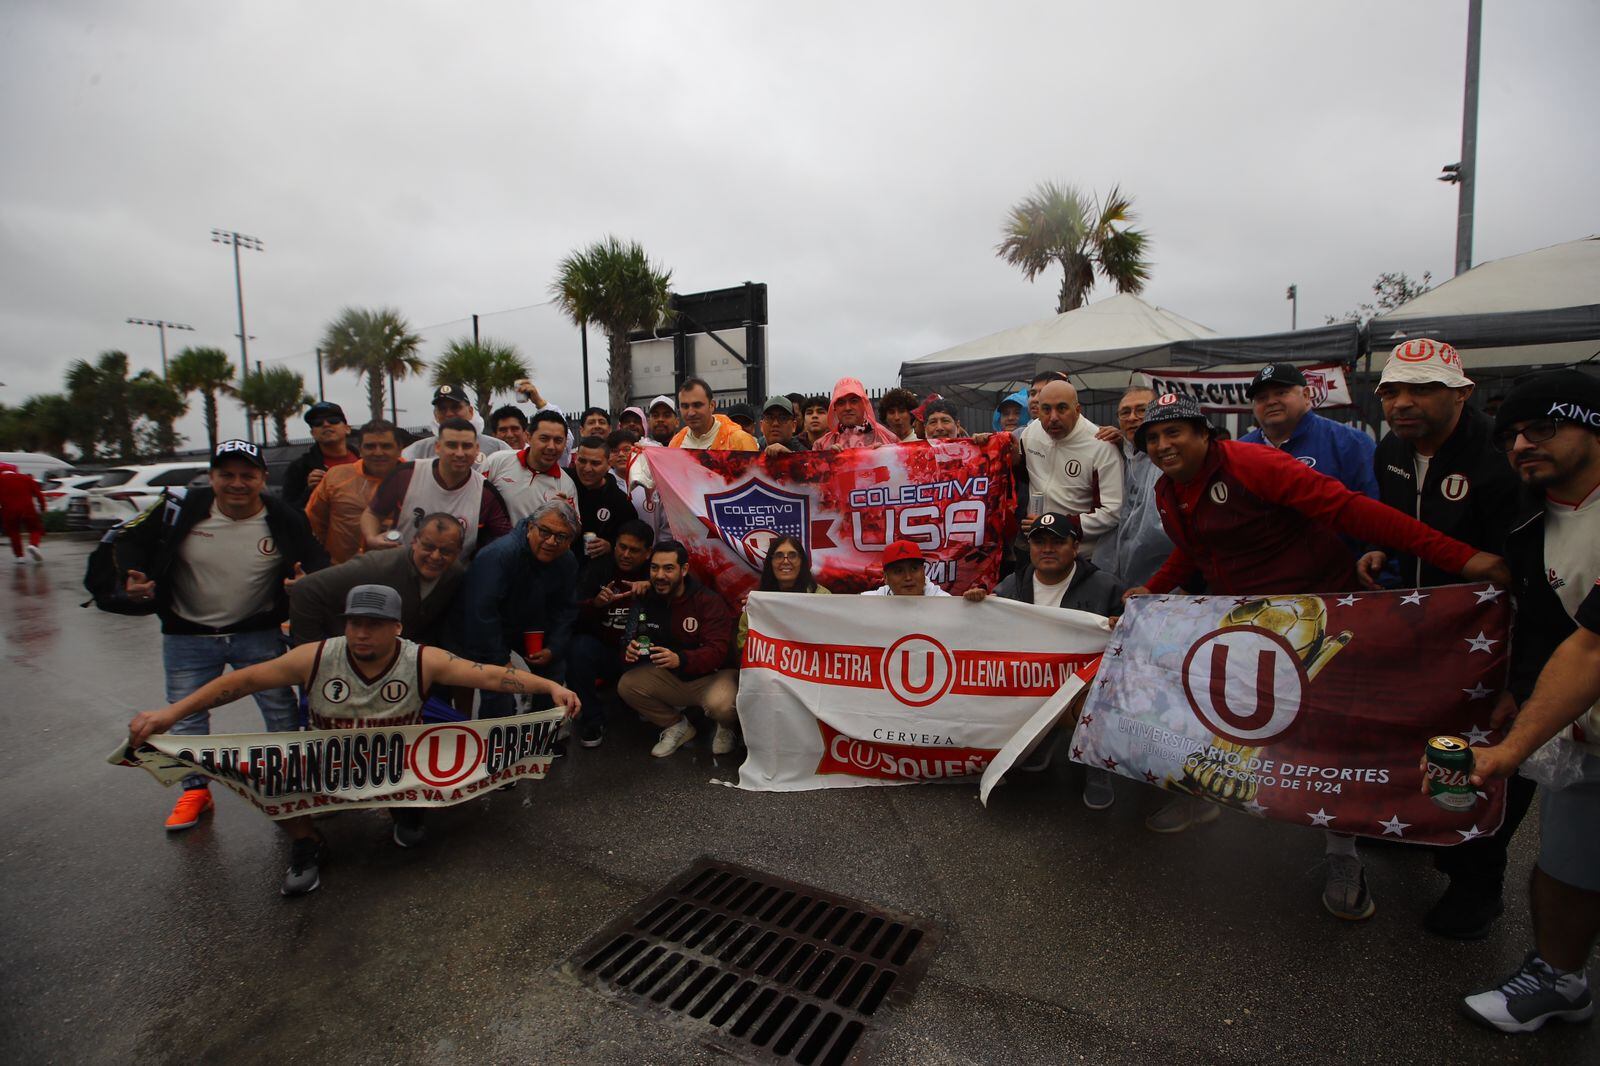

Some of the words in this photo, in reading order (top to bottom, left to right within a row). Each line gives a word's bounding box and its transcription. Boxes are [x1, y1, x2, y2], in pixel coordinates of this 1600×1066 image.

[1152, 378, 1253, 405] COLECTI
[850, 476, 989, 508] COLECTIVO
[723, 504, 793, 516] COLECTIVO
[744, 516, 776, 527] USA
[851, 500, 987, 552] USA
[924, 559, 957, 584] MI
[746, 636, 776, 666] UNA
[780, 646, 820, 678] SOLA
[824, 652, 872, 683] LETRA
[960, 659, 1007, 688] LLENA
[1010, 661, 1055, 688] TODA
[873, 728, 955, 745] CERVEZA
[1118, 716, 1241, 766] UNIVERSITARIO
[1247, 757, 1275, 774] DE
[1279, 762, 1390, 784] DEPORTES
[248, 732, 406, 798] FRANCISCO
[1141, 742, 1199, 769] FUNDADO
[1200, 760, 1212, 773] 7
[1214, 767, 1276, 787] AGOSTO
[1280, 778, 1300, 790] DE
[1305, 780, 1342, 795] 1924
[1426, 762, 1471, 786] Pils
[422, 789, 446, 802] VA
[450, 788, 464, 800] A
